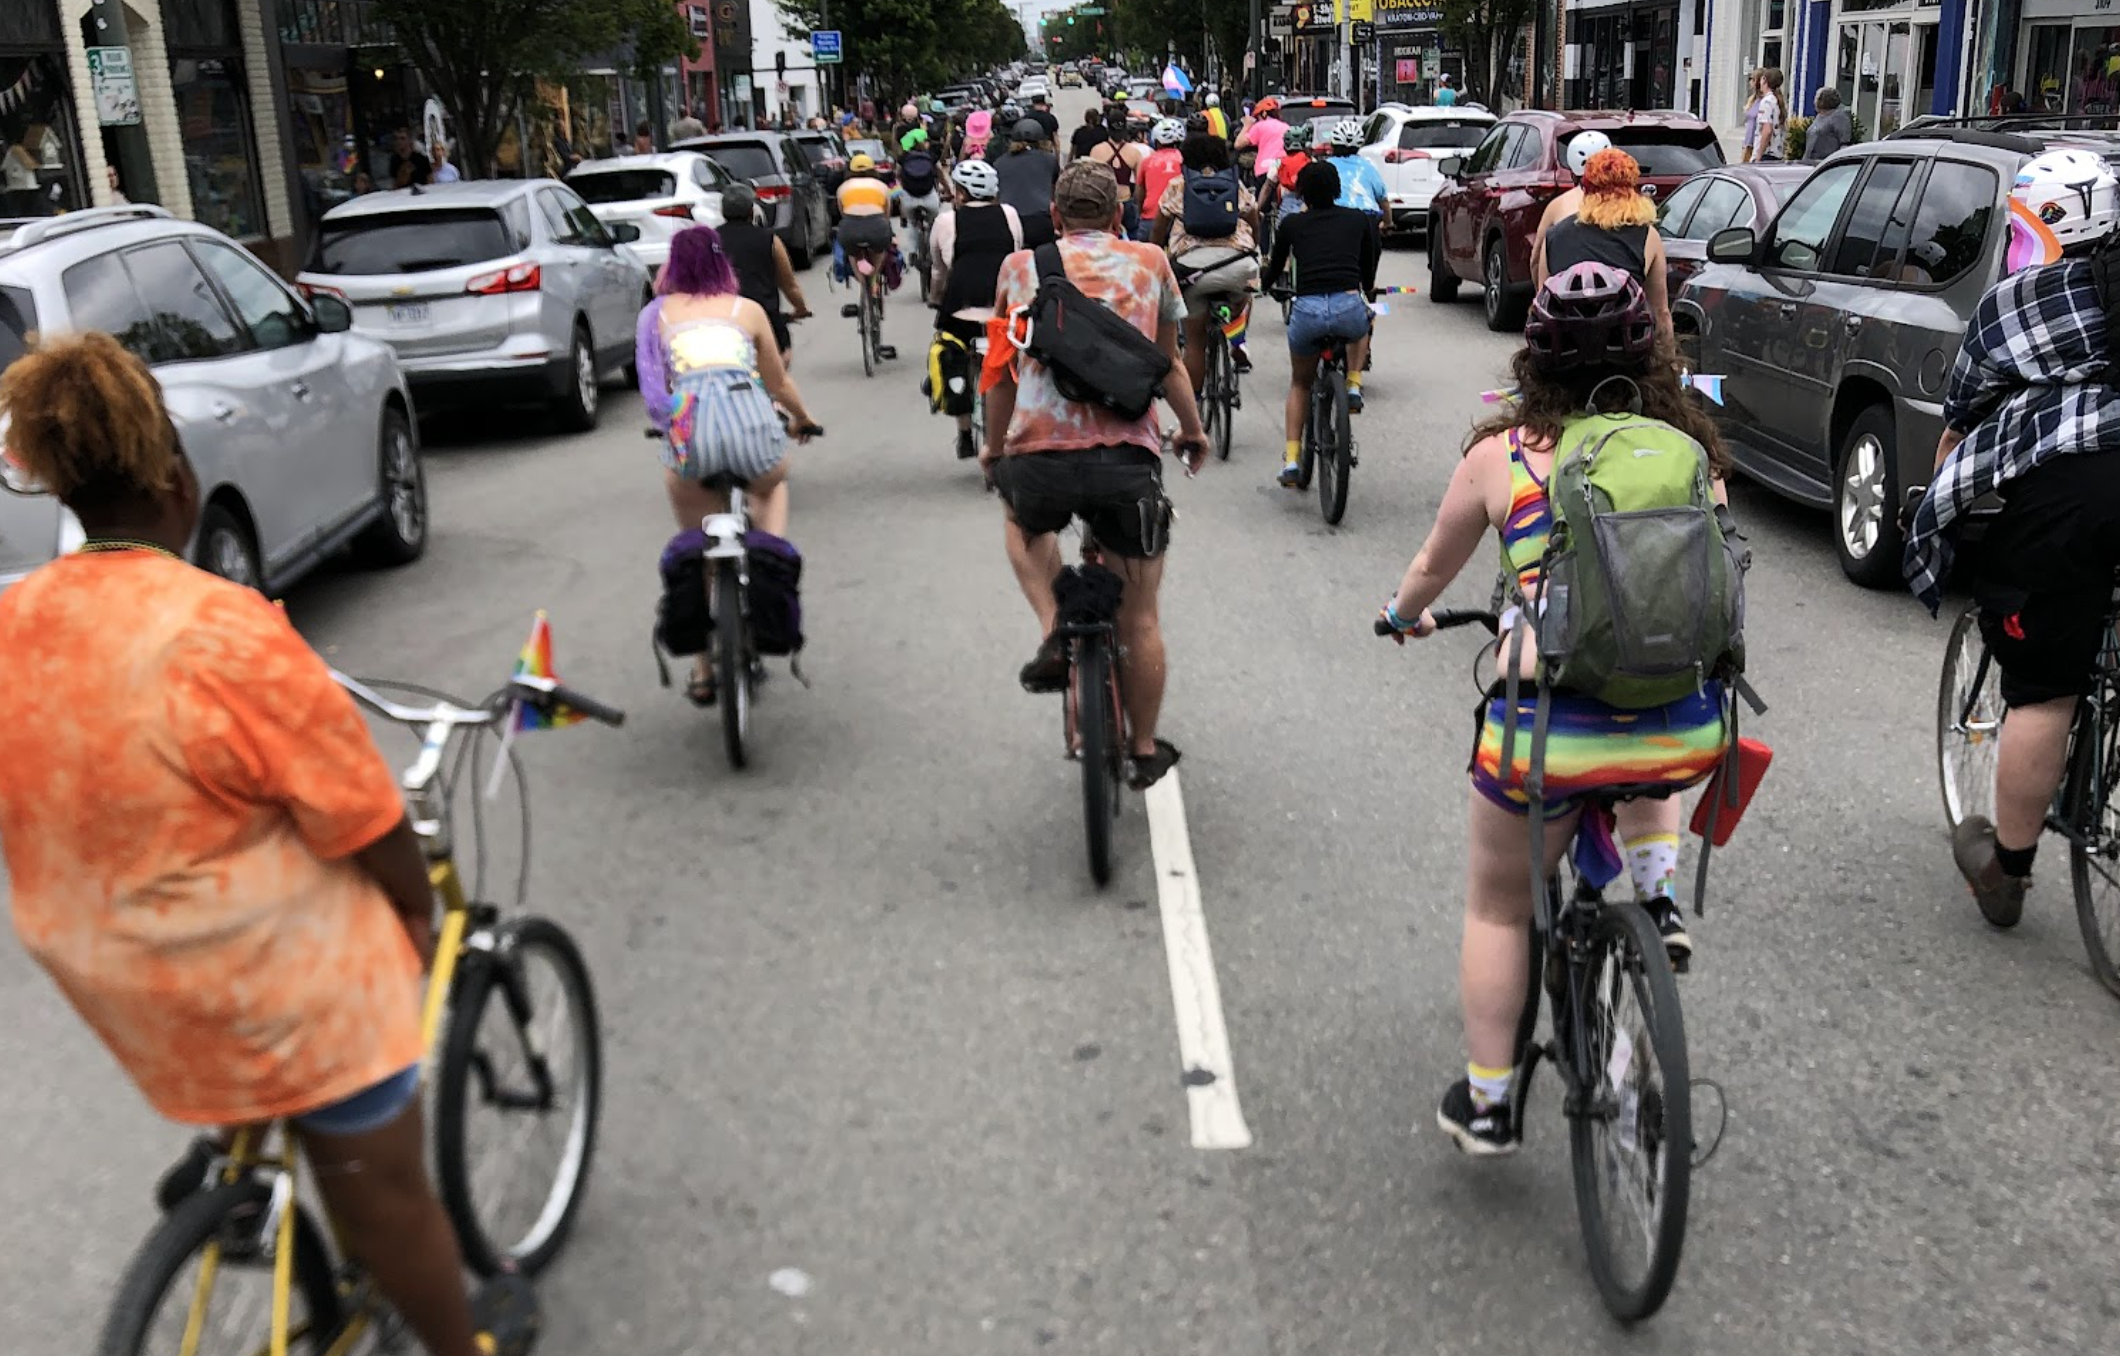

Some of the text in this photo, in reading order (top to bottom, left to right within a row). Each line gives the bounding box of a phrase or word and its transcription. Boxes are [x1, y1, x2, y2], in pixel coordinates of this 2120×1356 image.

[1312, 4, 1334, 14] T-Shi
[1314, 14, 1335, 24] Studi
[1394, 46, 1421, 56] HOOKAH
